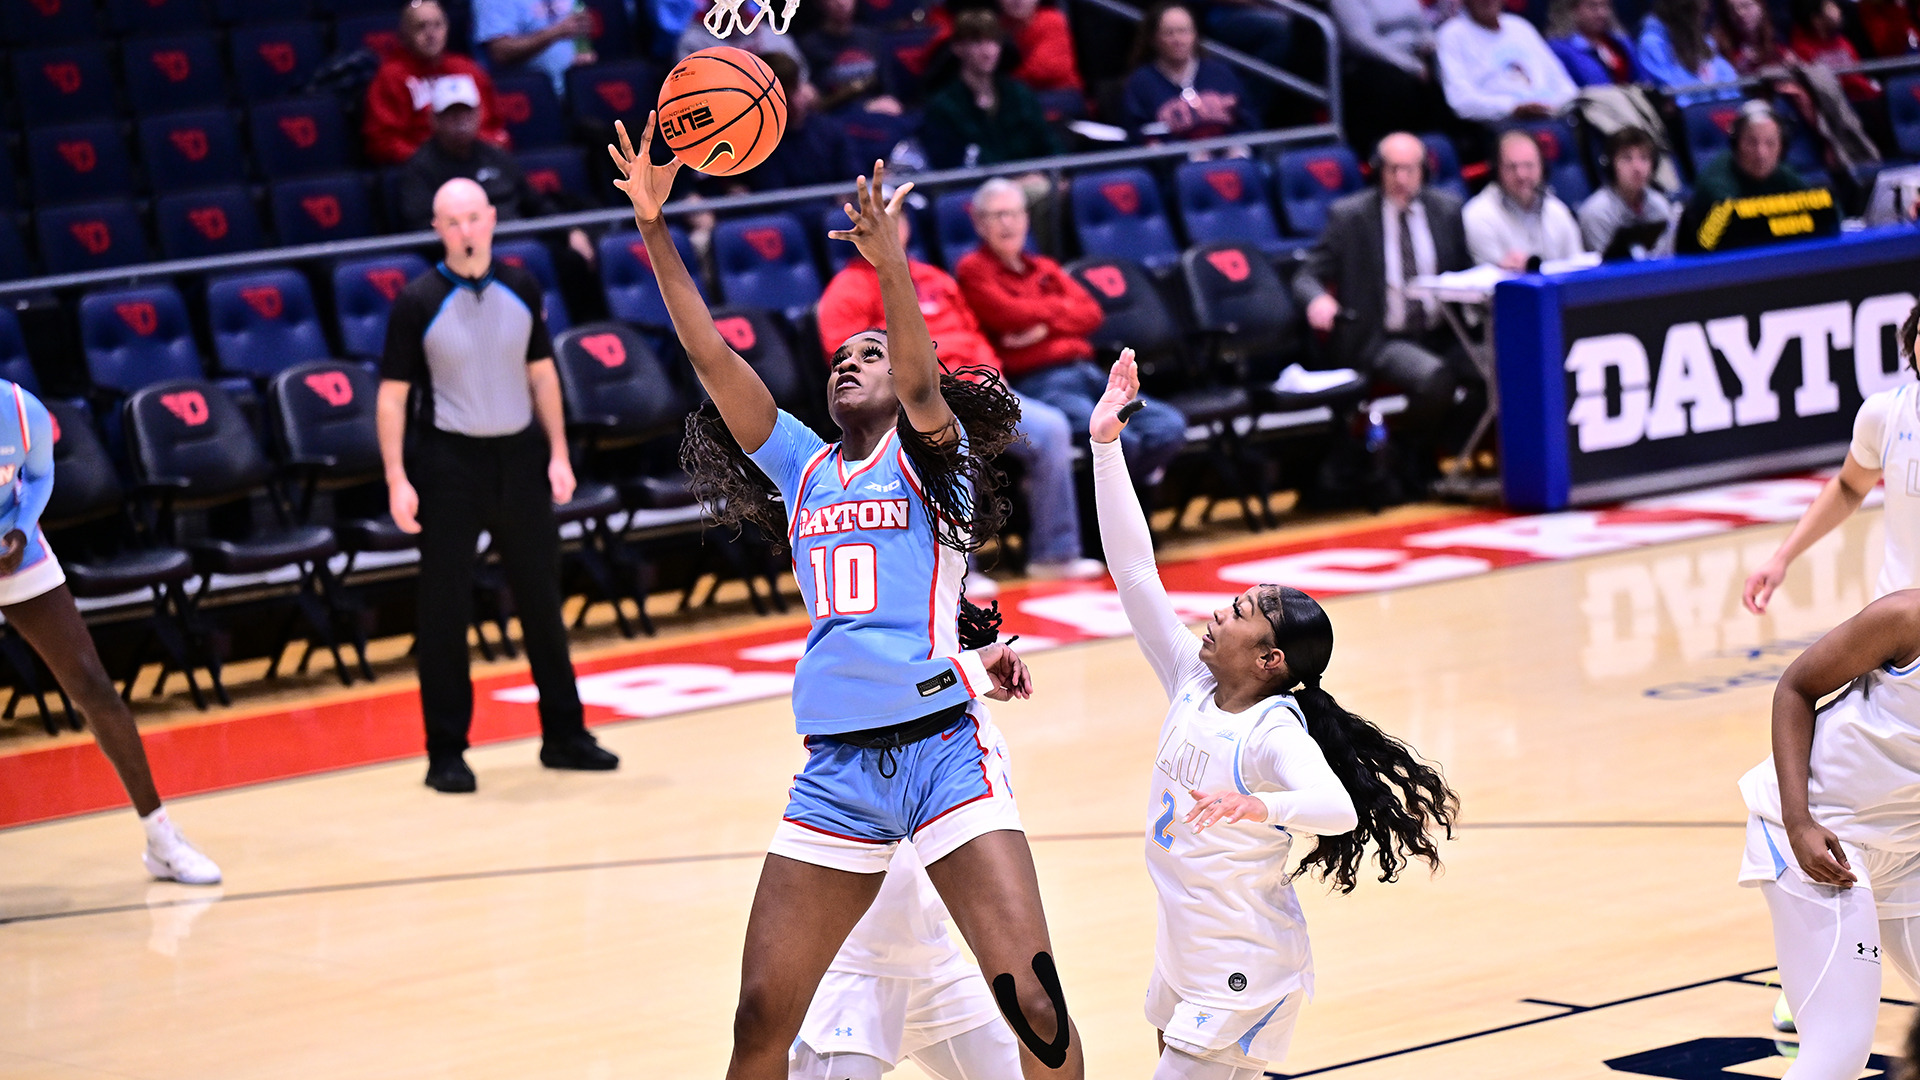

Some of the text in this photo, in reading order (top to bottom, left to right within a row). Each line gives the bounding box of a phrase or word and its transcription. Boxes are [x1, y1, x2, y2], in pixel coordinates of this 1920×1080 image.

[661, 105, 716, 141] ELITE
[809, 542, 878, 620] 10
[943, 675, 952, 684] M
[1151, 788, 1178, 853] 2
